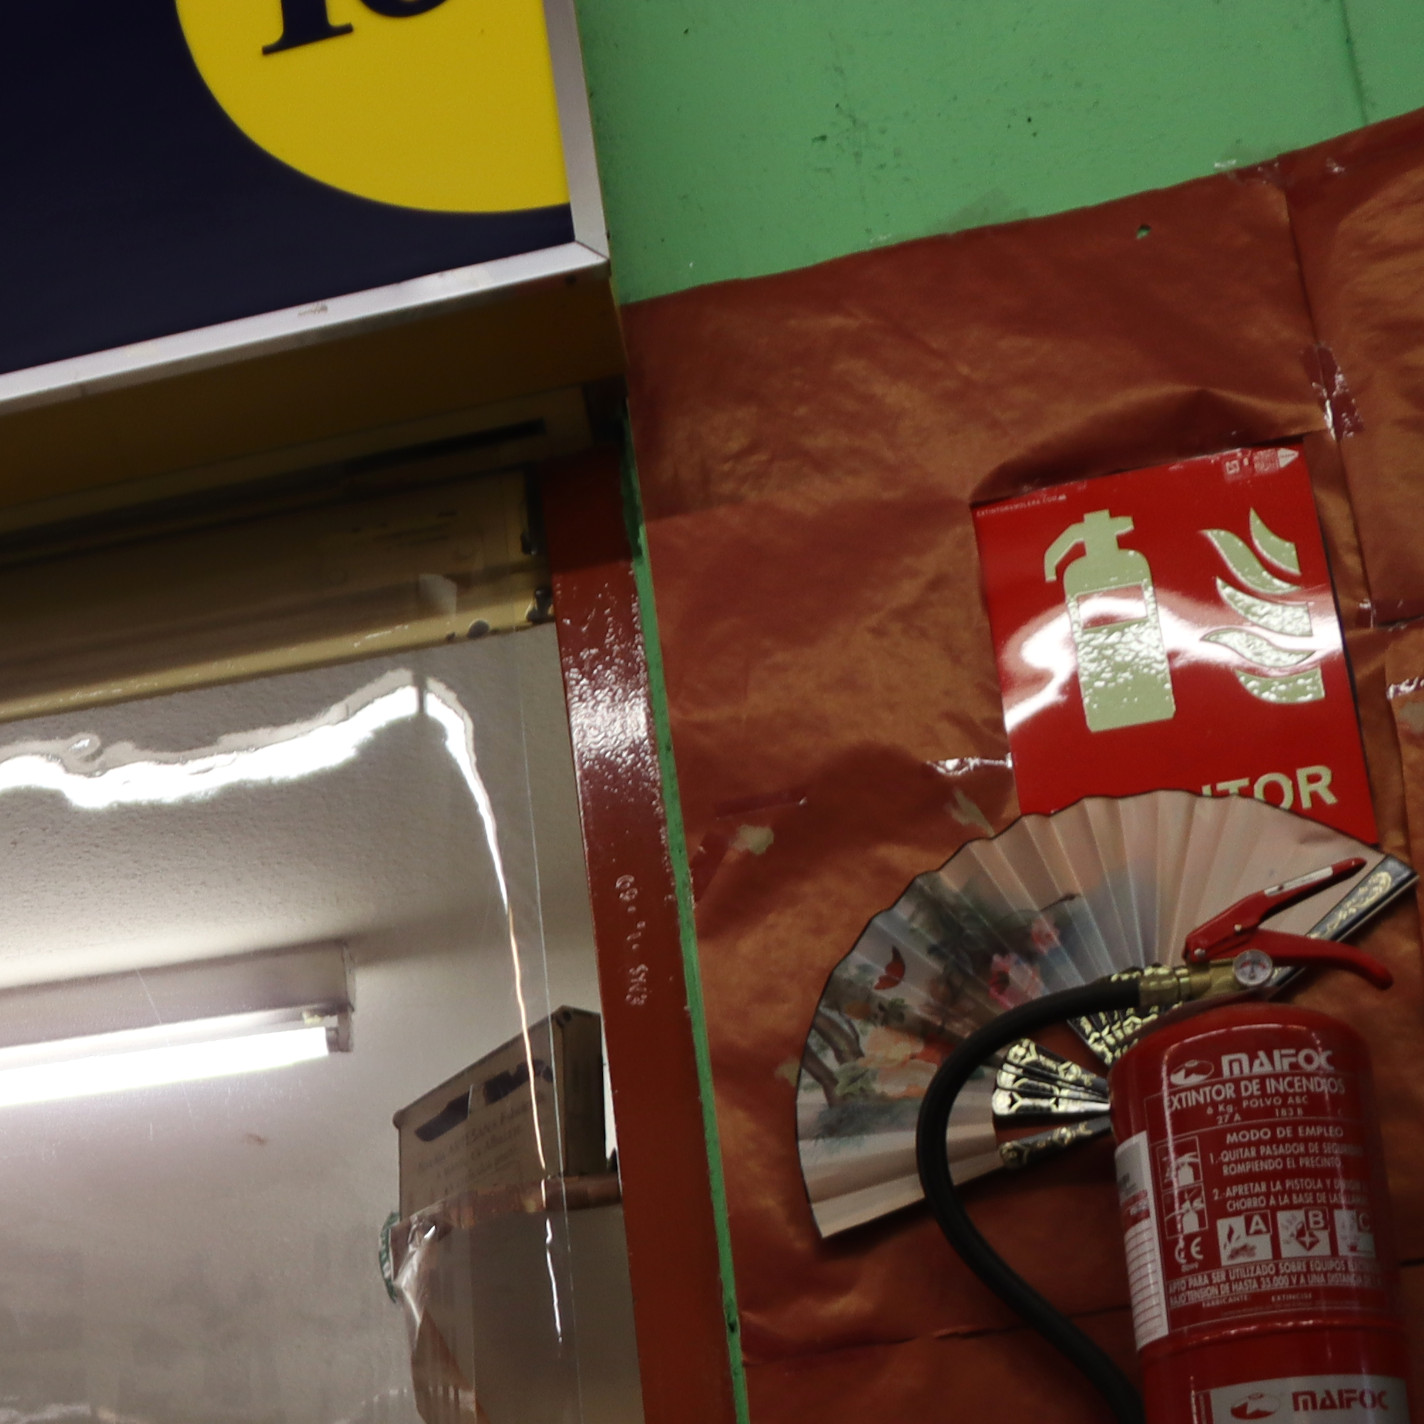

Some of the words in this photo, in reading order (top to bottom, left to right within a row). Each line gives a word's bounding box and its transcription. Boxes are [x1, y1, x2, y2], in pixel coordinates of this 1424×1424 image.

[1165, 1082, 1236, 1112] EXTINTOR
[1240, 1079, 1262, 1096] DE
[1266, 1075, 1345, 1095] INCENDIOS
[1242, 1096, 1282, 1108] POLVO
[1226, 1127, 1271, 1145] MODO
[1276, 1126, 1293, 1138] DE
[1298, 1125, 1344, 1138] EMPLEO
[1222, 1158, 1283, 1176] ROMPIENDO
[1286, 1157, 1297, 1168] EL
[1270, 1180, 1282, 1191] LA
[1285, 1178, 1323, 1190] PISTOLA
[1226, 1196, 1266, 1212] CHORRO
[1249, 1216, 1267, 1234] A
[1308, 1210, 1325, 1229] B
[1211, 1270, 1226, 1283] SER
[1229, 1262, 1276, 1280] UTILIZADO
[1278, 1260, 1307, 1274] SOBRE
[1310, 1258, 1345, 1273] EQUIPOS
